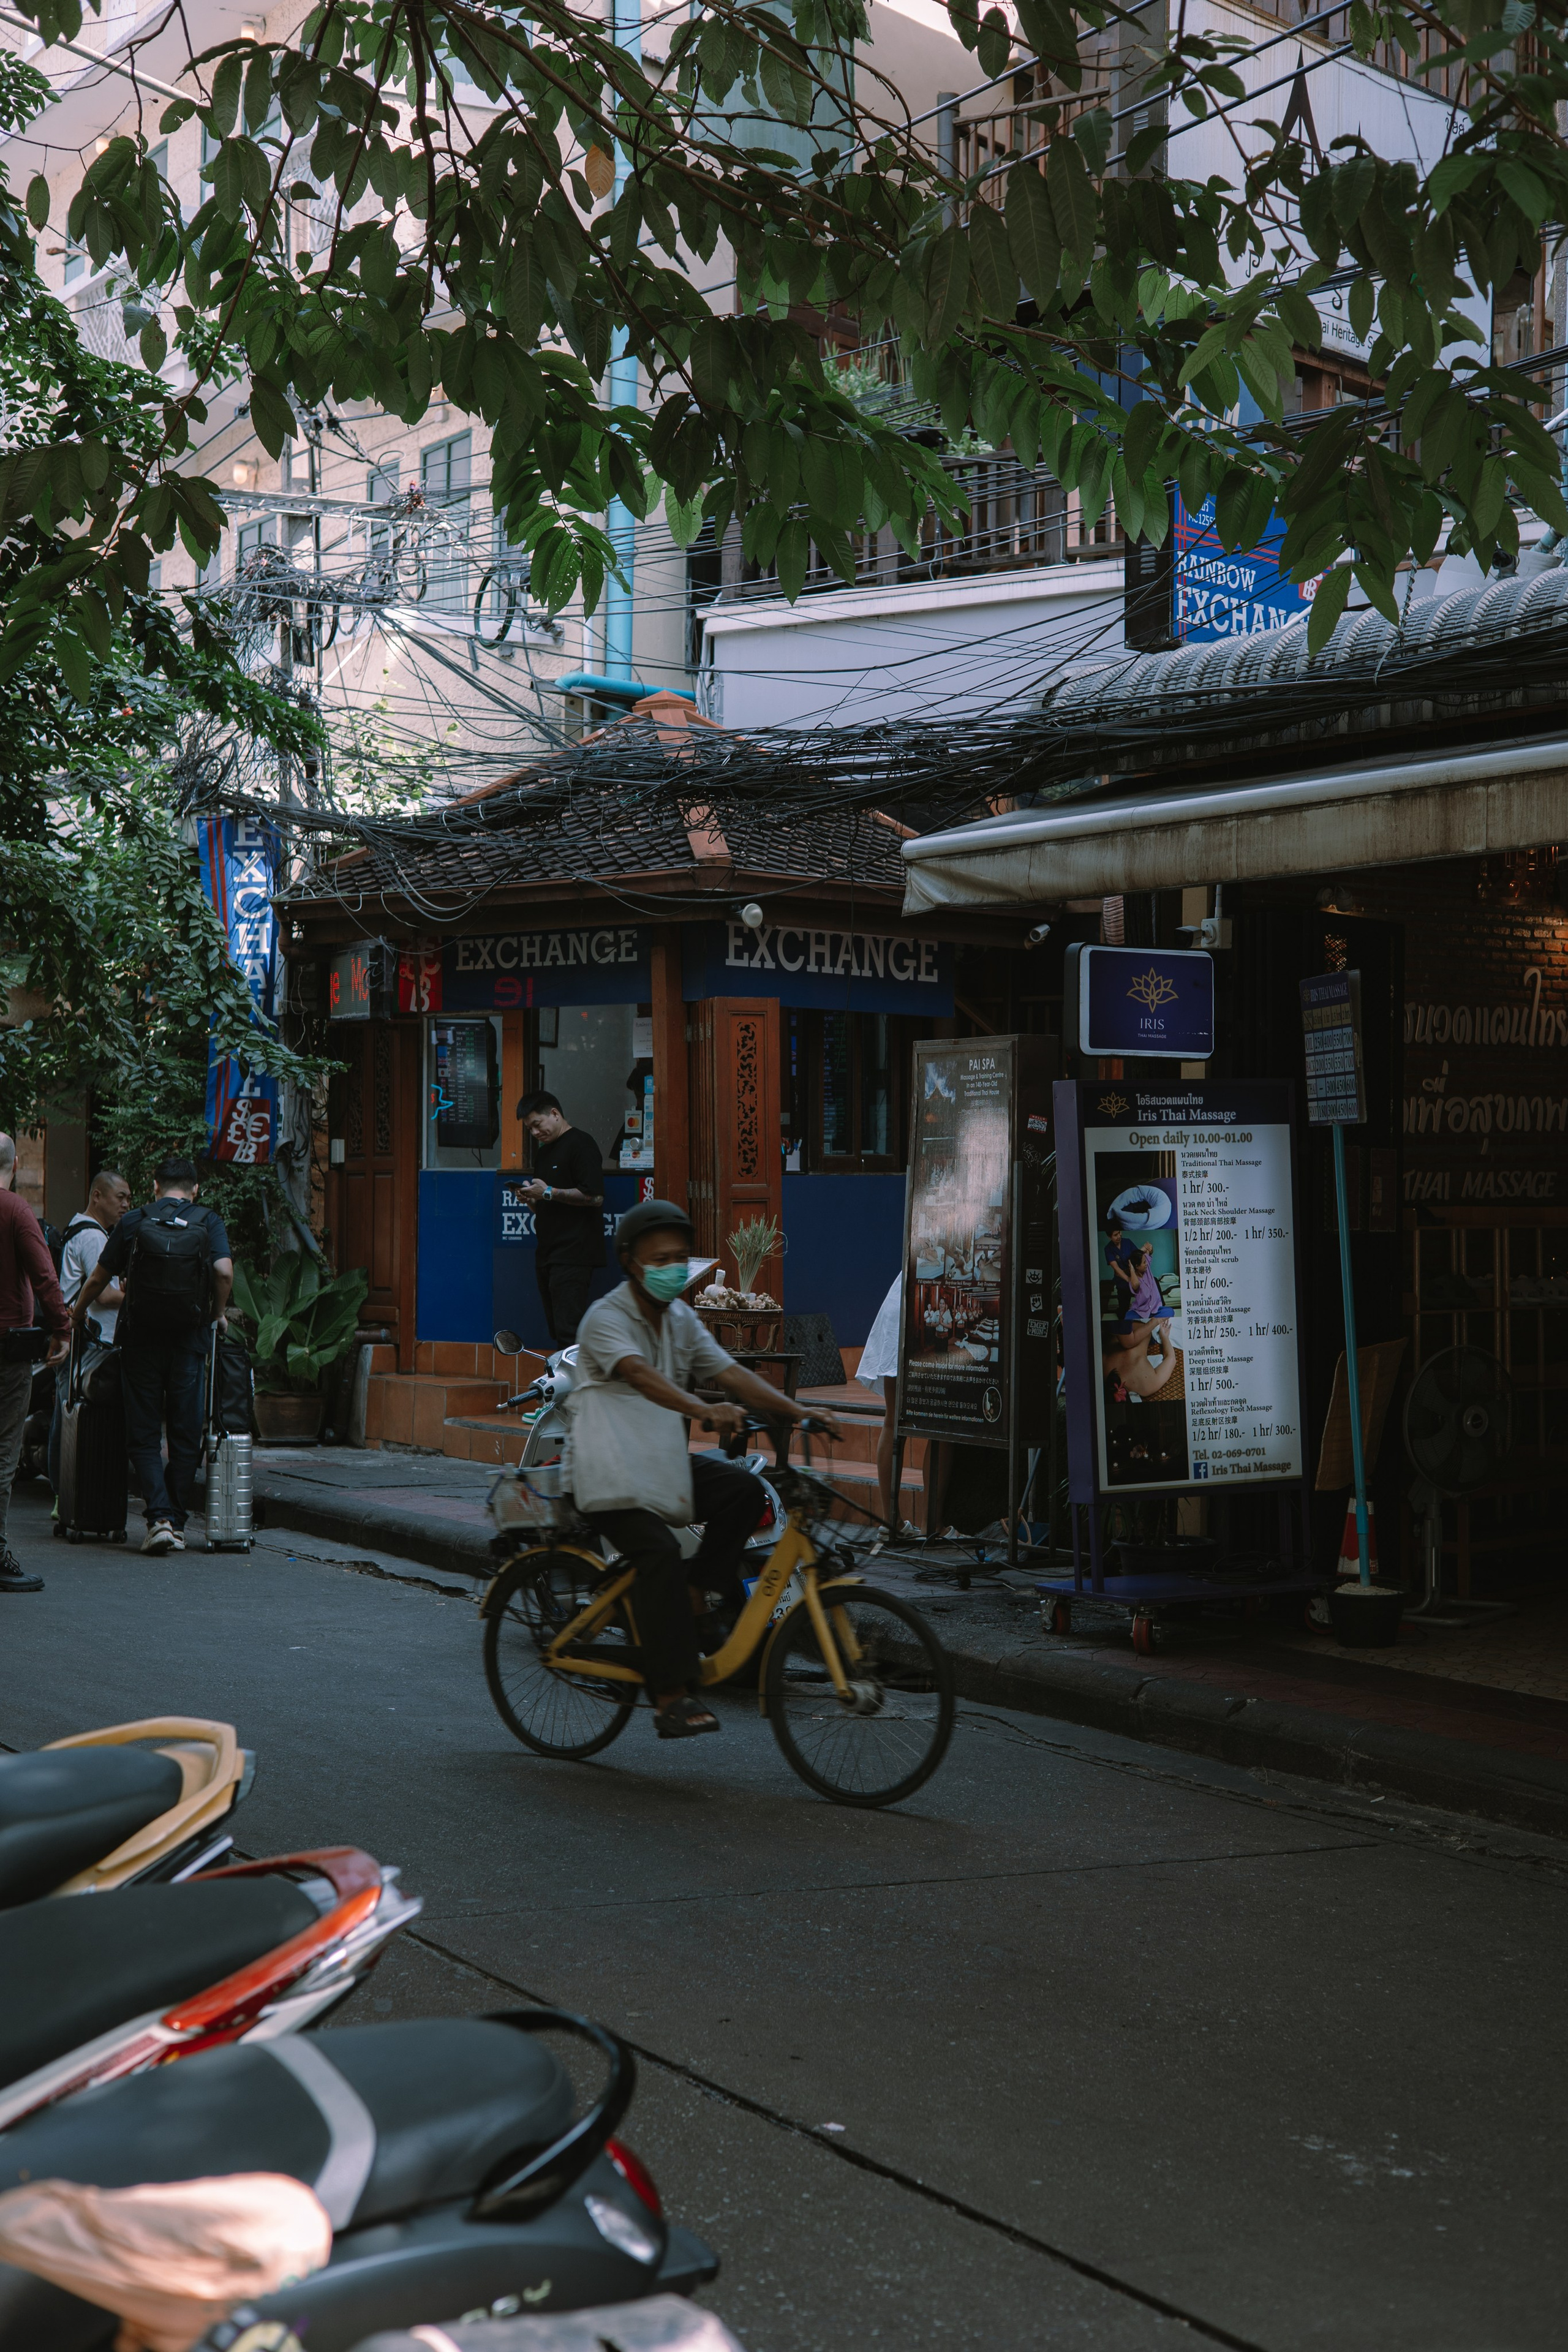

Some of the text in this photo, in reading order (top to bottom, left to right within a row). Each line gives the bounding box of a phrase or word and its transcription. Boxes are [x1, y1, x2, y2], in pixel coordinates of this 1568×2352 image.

[1177, 551, 1256, 593] RAINBOW
[1177, 584, 1309, 636] EXCHAN
[456, 929, 638, 971] EXCHANGE
[725, 920, 938, 982] EXCHANGE
[1319, 986, 1330, 1001] THAI
[1331, 982, 1348, 1000] MASSAGE
[1140, 1018, 1164, 1030] IRIS
[1314, 1036, 1323, 1049] 250
[1324, 1035, 1332, 1048] 400
[1333, 1034, 1342, 1046] 550
[1343, 1032, 1352, 1045] 700
[969, 1058, 995, 1071] PAI SPA
[1335, 1055, 1344, 1069] 550
[1344, 1054, 1354, 1068] 700
[1308, 1078, 1355, 1096] THAI 300 450 600
[1137, 1109, 1237, 1123] Iris Thai Massage
[1309, 1104, 1318, 1118] FOOT
[1327, 1102, 1336, 1117] 300
[1337, 1102, 1347, 1116] 450
[1348, 1101, 1357, 1115] 600
[1129, 1131, 1253, 1148] Open daily 10.00-01.00
[1182, 1148, 1218, 1158] นวดแผนไทย
[1183, 1180, 1229, 1194] 1 hr/ 300.-
[1403, 1168, 1558, 1200] THAI MASSAGE
[1183, 1217, 1237, 1226] 背部颈部肩部按摩
[1185, 1226, 1289, 1242] 1/2 hr/ 200.- 1 hr/ 350.-
[1185, 1245, 1231, 1257] ขัดเกลือสมุนไพร
[1185, 1265, 1212, 1275] 草本磨砂
[1186, 1276, 1233, 1289] 1 hr/ 600.-
[1187, 1315, 1234, 1325] 芳香瑞典油按摩
[1188, 1323, 1293, 1340] 1/2 hr/ 250.- 1 hr/ 400.-
[1189, 1346, 1223, 1357] นวดดีพทิชชู
[966, 1364, 989, 1373] information
[1189, 1366, 1229, 1375] 深层组织按摩
[1191, 1378, 1238, 1391] 1 hr/ 500.-
[1191, 1415, 1238, 1427] 足底反射区按摩
[1193, 1423, 1296, 1441] 1/2 hr/ 180.- 1 hr/ 300.-
[1193, 1447, 1266, 1460] Tel. 02-069-0701
[1212, 1461, 1291, 1476] Iris Thai Massage
